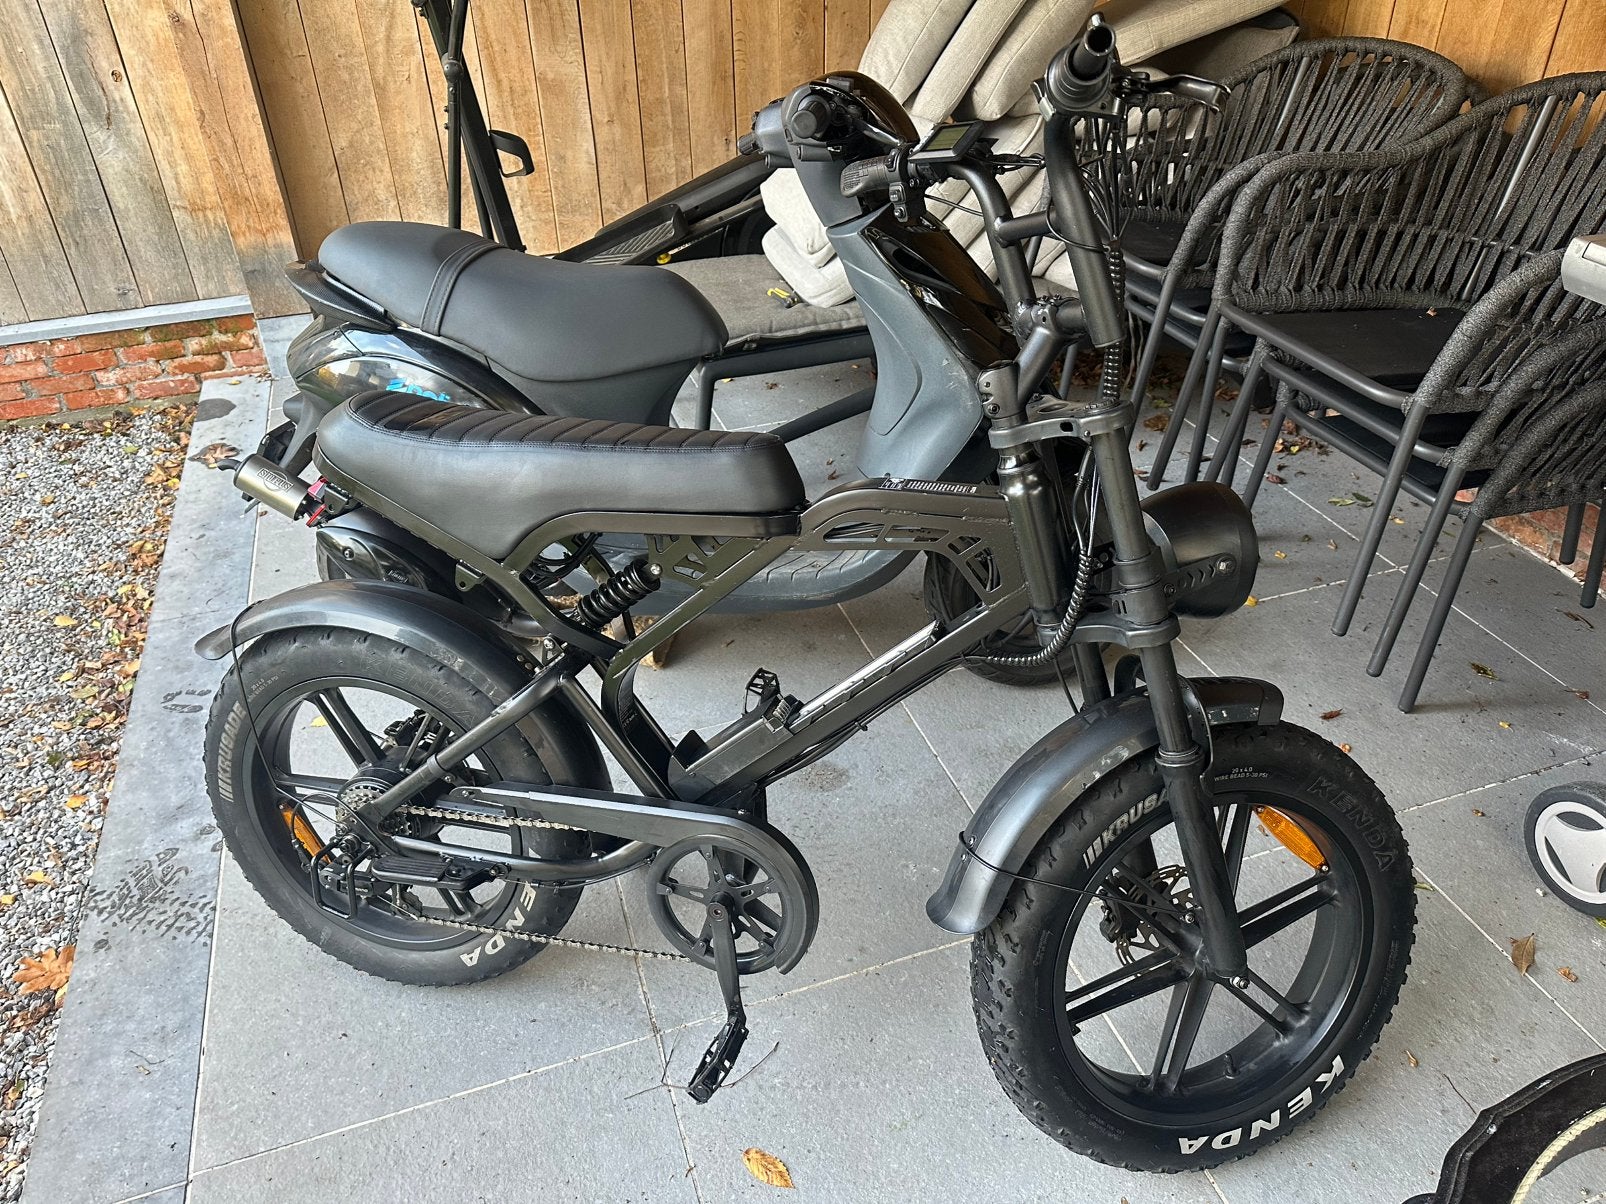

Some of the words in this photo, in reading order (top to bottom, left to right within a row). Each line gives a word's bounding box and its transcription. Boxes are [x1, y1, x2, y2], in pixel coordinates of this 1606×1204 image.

[217, 700, 248, 784] KRUSADE
[1306, 776, 1399, 872] KENDA
[459, 848, 541, 967] ENDA
[1178, 1054, 1345, 1155] KENDA
